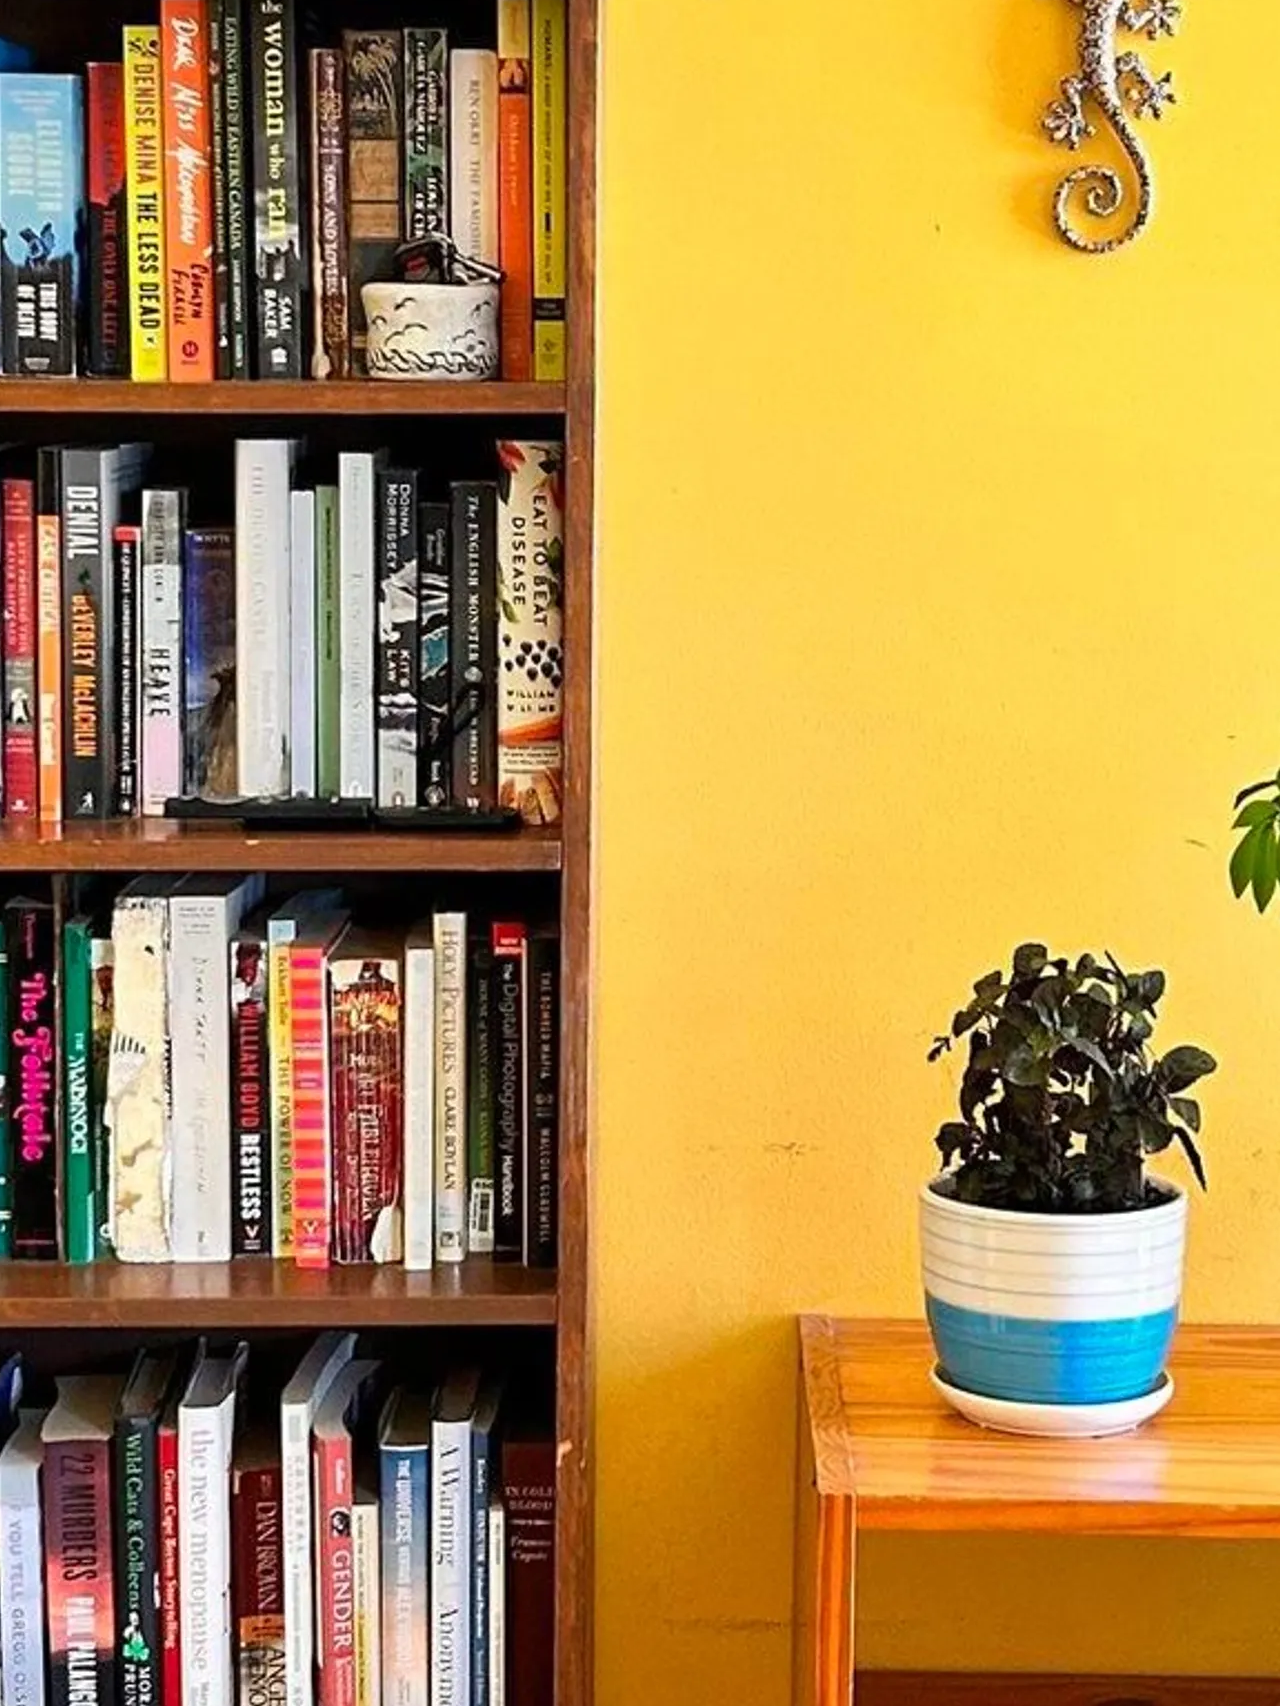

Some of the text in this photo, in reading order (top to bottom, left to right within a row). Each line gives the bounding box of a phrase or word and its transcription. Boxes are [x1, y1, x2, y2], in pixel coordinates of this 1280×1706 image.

[262, 22, 290, 137] woman
[224, 17, 244, 250] EATING WILD EASTERN CANADA
[267, 144, 286, 179] who
[133, 63, 162, 330] DENISE MINA THE LESS DEAD
[266, 187, 291, 242] ran
[16, 285, 36, 338] OF DEATH
[39, 283, 59, 342] THIS BODY
[263, 288, 278, 339] BAKER
[277, 296, 292, 330] SAM
[68, 486, 98, 559] DENIAL
[386, 483, 397, 569] MORRISSEY
[399, 483, 411, 537] DONNA
[467, 496, 479, 661] The ENGLISH MONSTER
[511, 516, 527, 606] DISEASE
[533, 494, 547, 626] EAT TO BEAT
[149, 648, 171, 718] HEAVE
[387, 649, 397, 683] LAW
[399, 649, 410, 688] KIT'S
[74, 675, 96, 757] McLACHLIN
[440, 930, 459, 1074] HOLY PICTURES
[498, 983, 518, 1039] Digital
[13, 973, 51, 1161] The Folktale
[239, 1003, 262, 1219] WILLIAM BOYD RESTLESS
[497, 1043, 519, 1153] Photography
[278, 1057, 293, 1217] THE POWER OF NOW
[444, 1086, 457, 1190] CLARE BOYLAN
[501, 1155, 514, 1215] Handbook
[60, 1453, 93, 1476] 22
[62, 1484, 96, 1581] MURDERS
[125, 1433, 144, 1610] Wild Cats & Colleens
[186, 1430, 215, 1670] the new menopause
[436, 1467, 461, 1567] Warning
[66, 1597, 96, 1638] PAUL
[331, 1550, 351, 1650] GENDER
